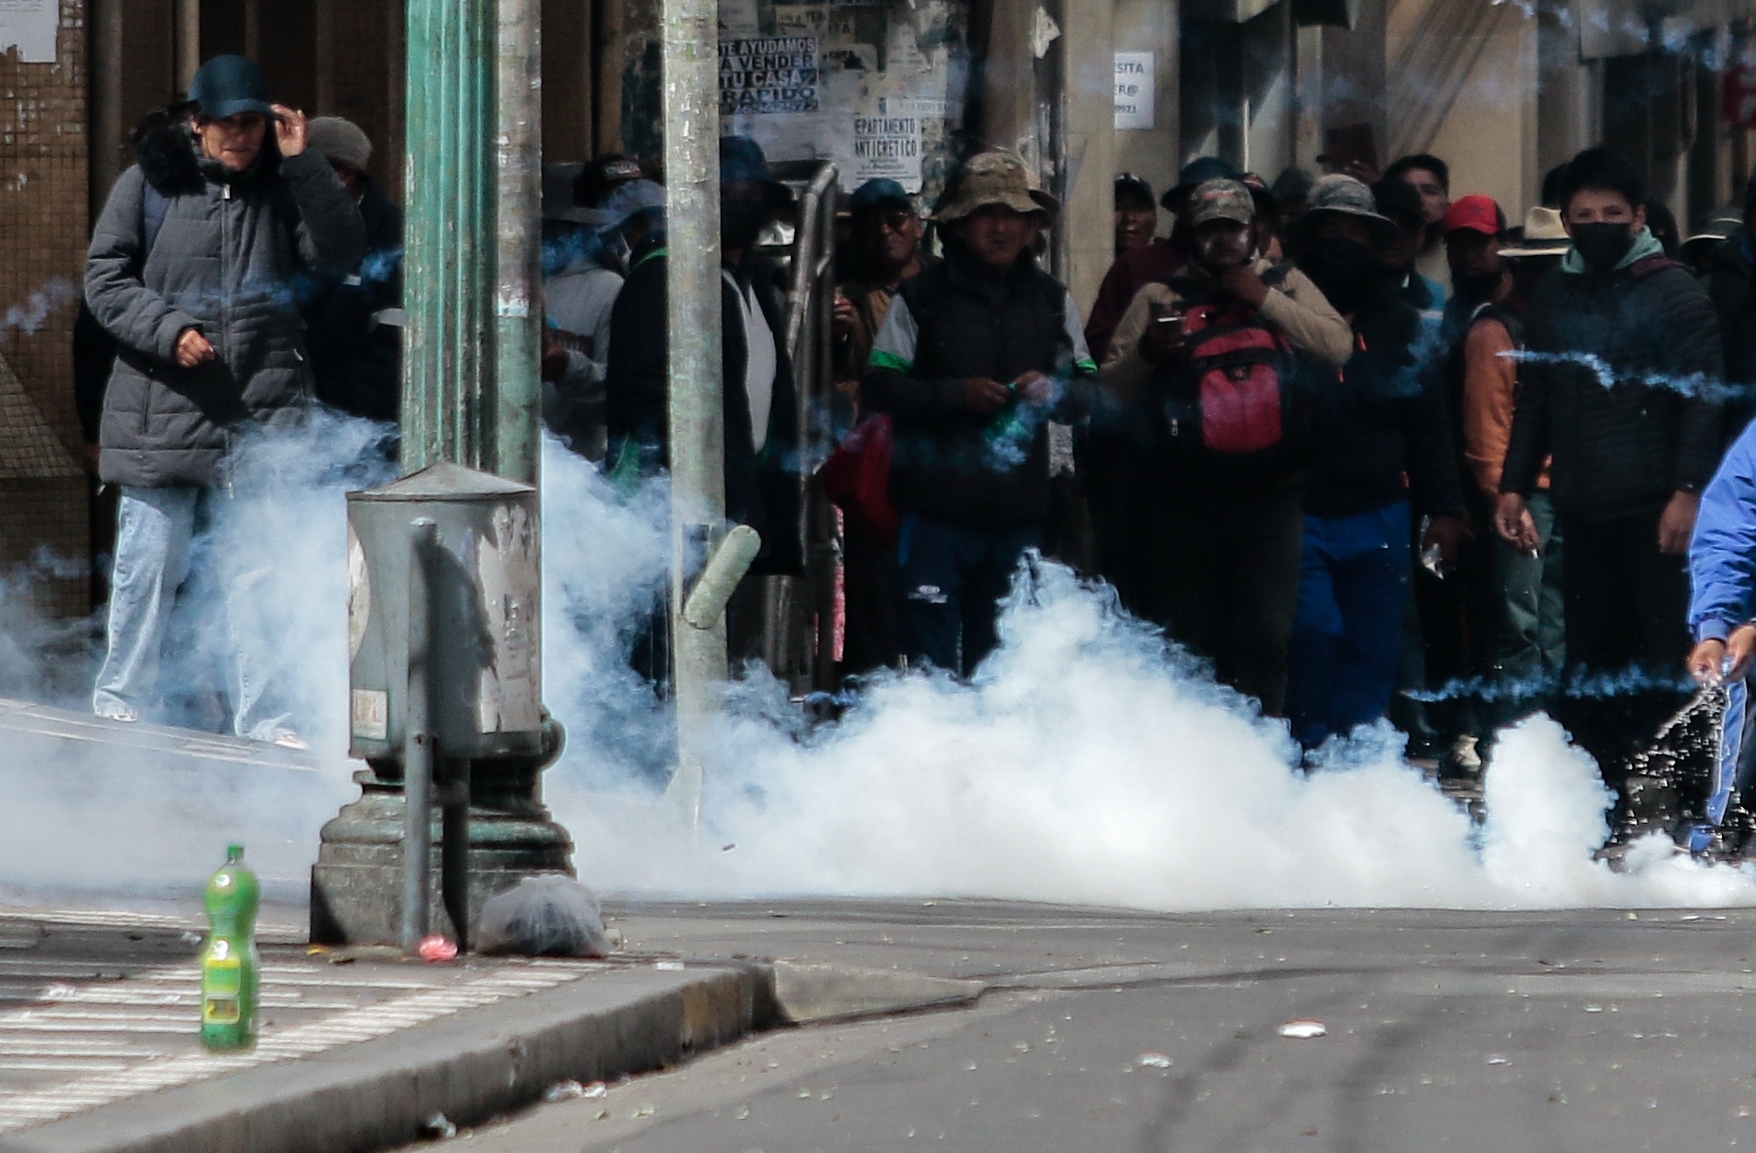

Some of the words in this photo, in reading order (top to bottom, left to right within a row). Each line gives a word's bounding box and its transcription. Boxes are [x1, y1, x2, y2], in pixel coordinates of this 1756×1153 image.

[740, 38, 814, 54] AYUDAMOS
[721, 57, 733, 70] A
[738, 54, 813, 69] VENDER
[720, 73, 746, 88] TU
[752, 69, 801, 87] CASA
